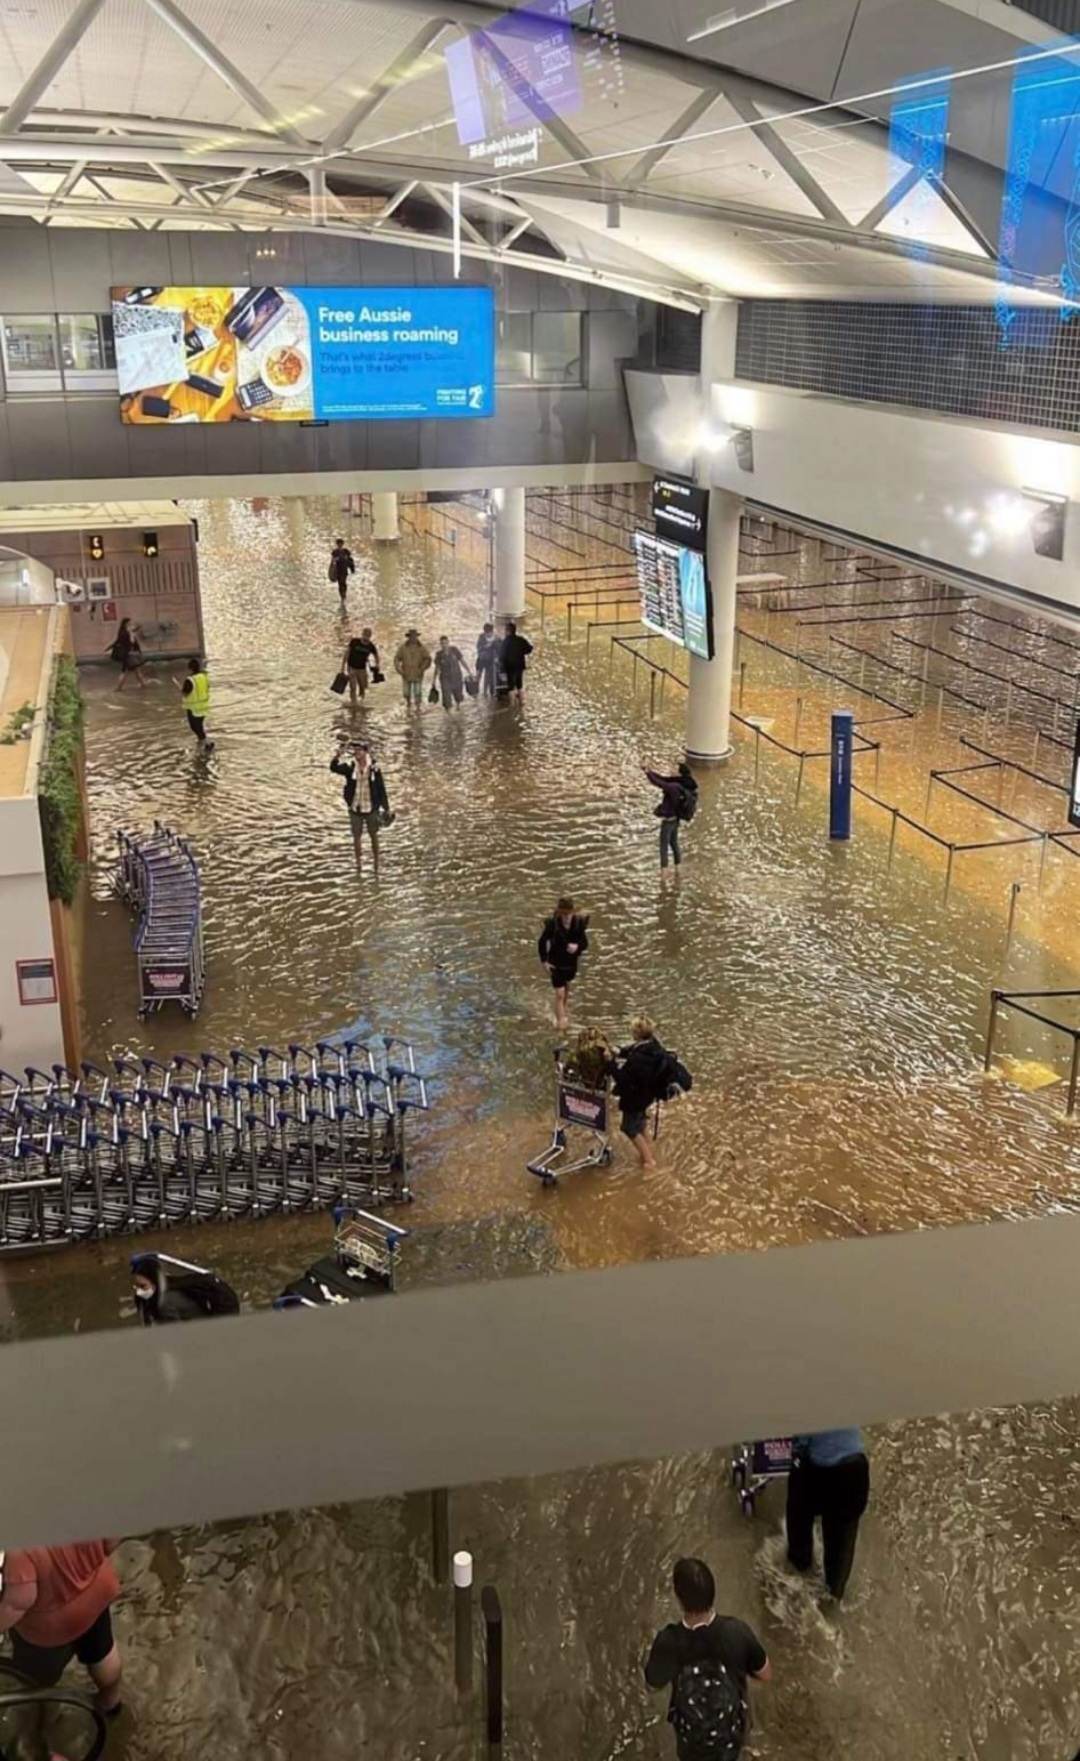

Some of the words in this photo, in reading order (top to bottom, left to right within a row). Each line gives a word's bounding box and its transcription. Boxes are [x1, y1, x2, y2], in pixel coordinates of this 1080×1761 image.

[318, 306, 355, 323] Free
[359, 306, 412, 323] Aussie
[319, 326, 389, 343] business
[393, 326, 459, 345] roaming
[320, 363, 351, 375] brings
